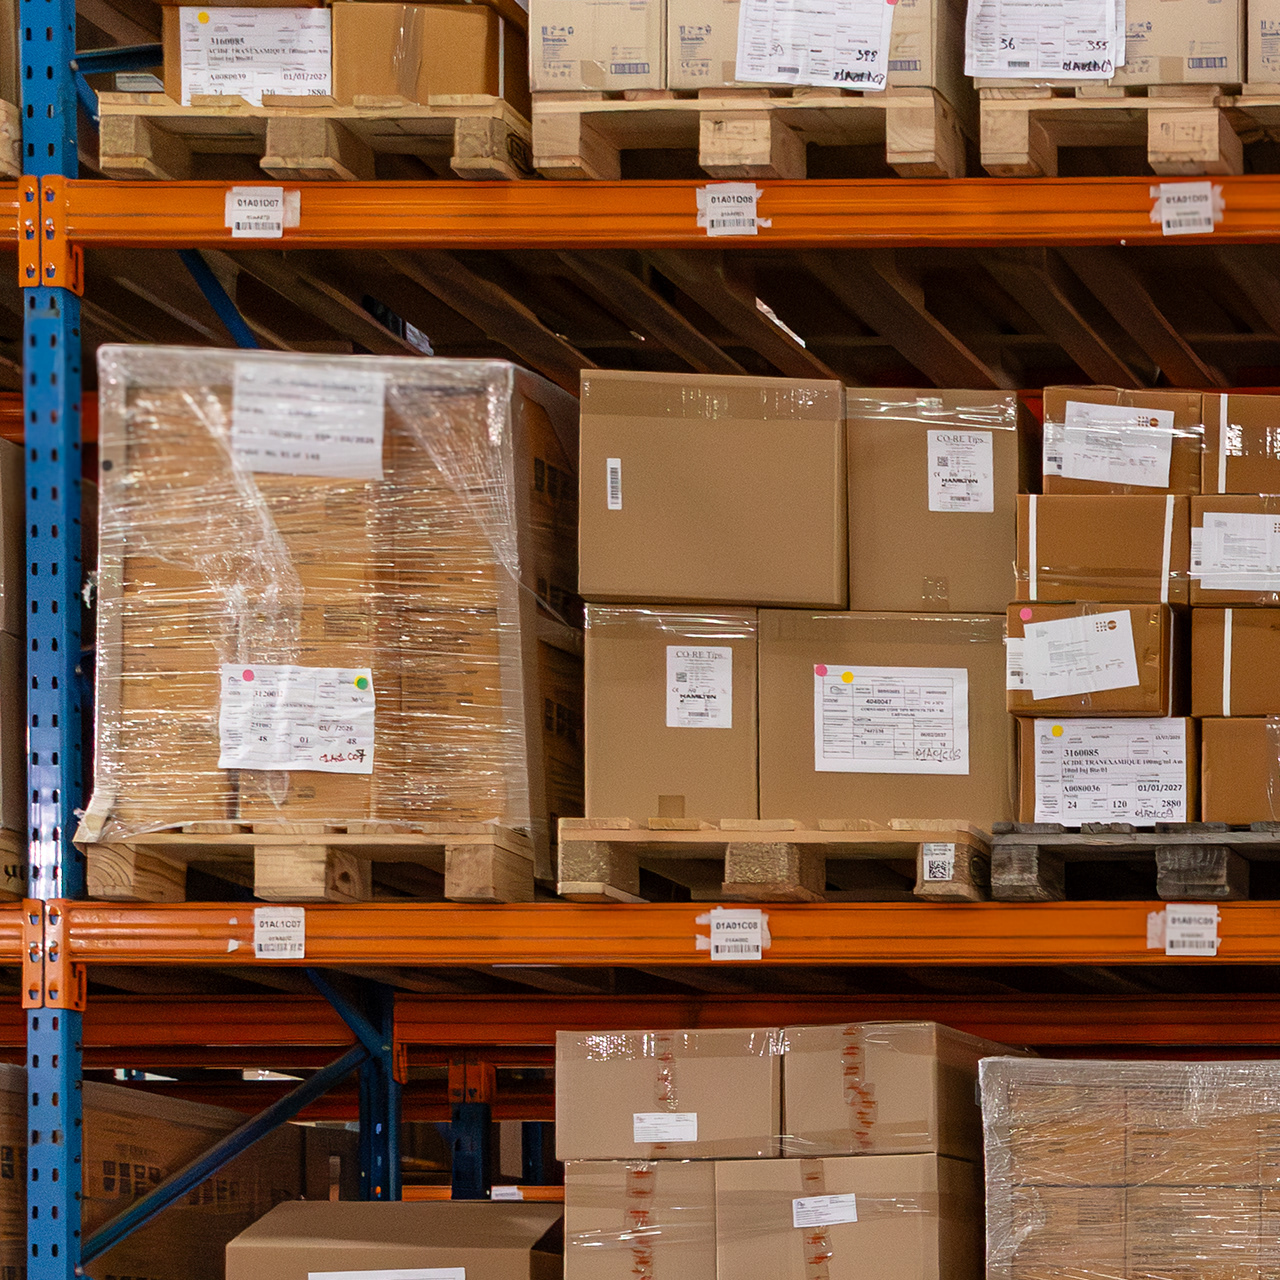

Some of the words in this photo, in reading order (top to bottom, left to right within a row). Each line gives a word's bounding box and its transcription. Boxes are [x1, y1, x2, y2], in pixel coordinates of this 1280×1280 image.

[237, 199, 279, 208] 01A01D07
[936, 435, 966, 443] CO-RE
[676, 650, 704, 659] CO-RE
[1063, 749, 1099, 757] 3160085
[1137, 784, 1183, 793] 01/01/2027
[1161, 800, 1182, 808] 2880
[716, 922, 758, 930] 01A01C08
